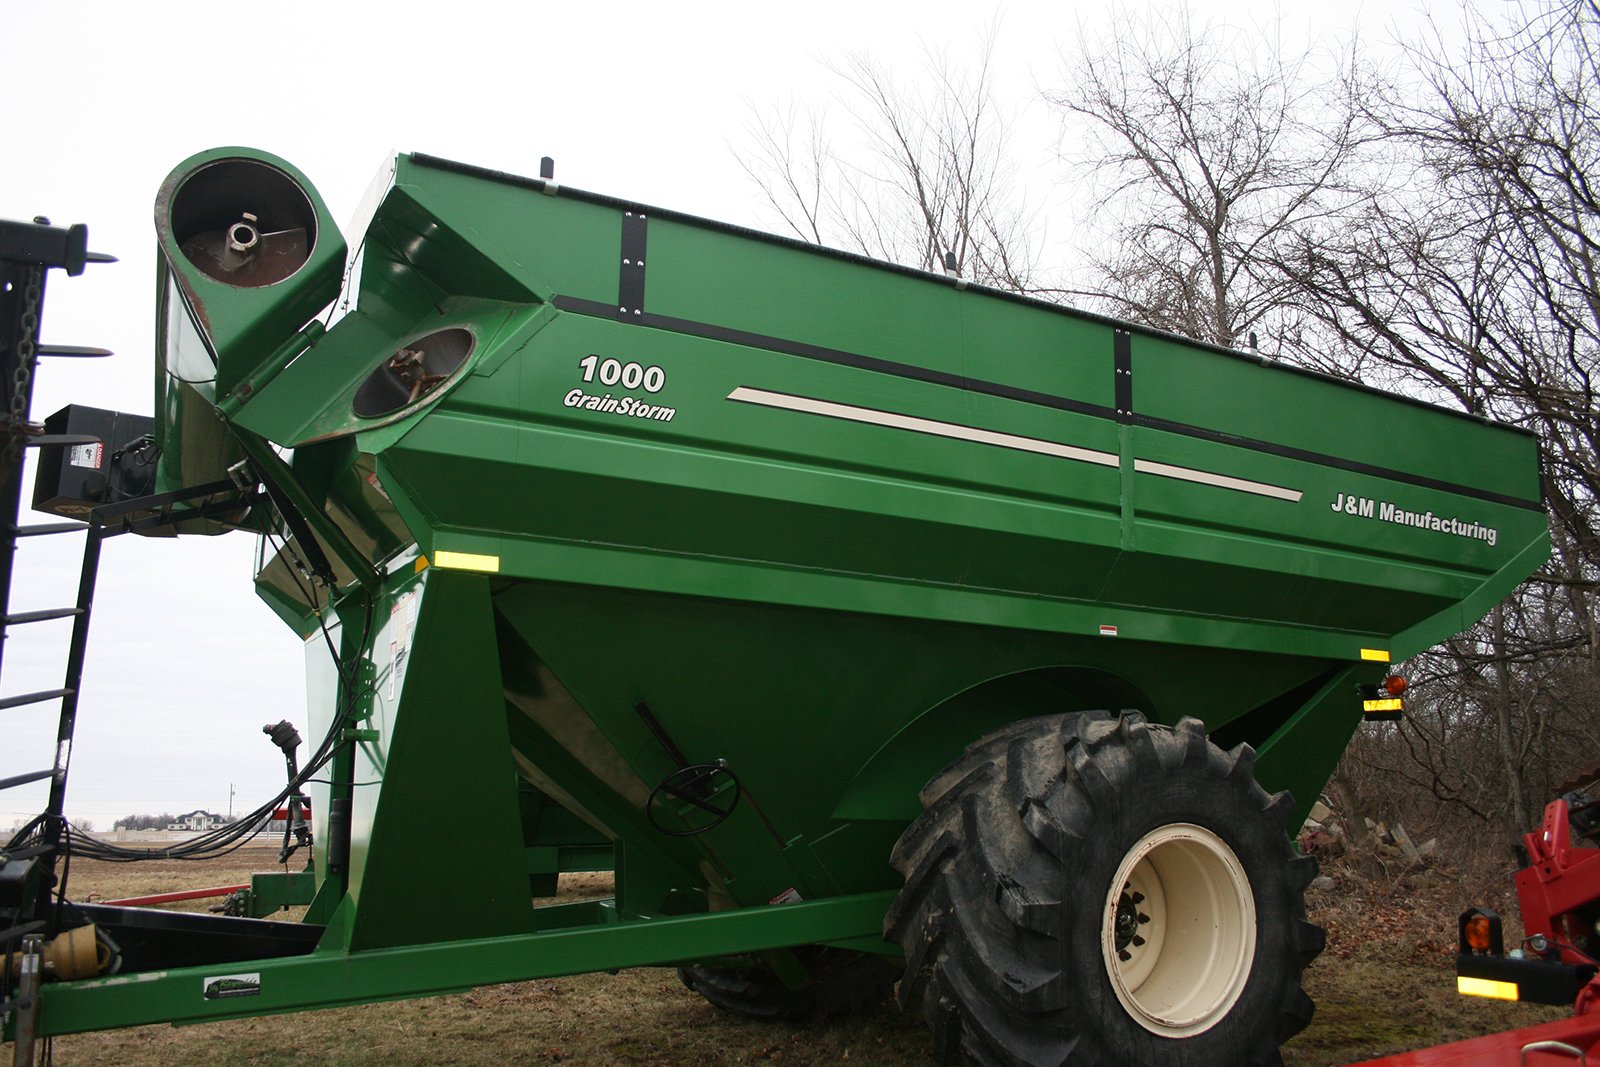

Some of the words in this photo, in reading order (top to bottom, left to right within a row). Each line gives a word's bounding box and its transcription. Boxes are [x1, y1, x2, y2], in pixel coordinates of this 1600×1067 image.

[579, 354, 666, 393] 1000
[563, 388, 677, 422] GrainStorm
[1331, 493, 1374, 518] J&M
[1379, 502, 1497, 546] Manufacturing
